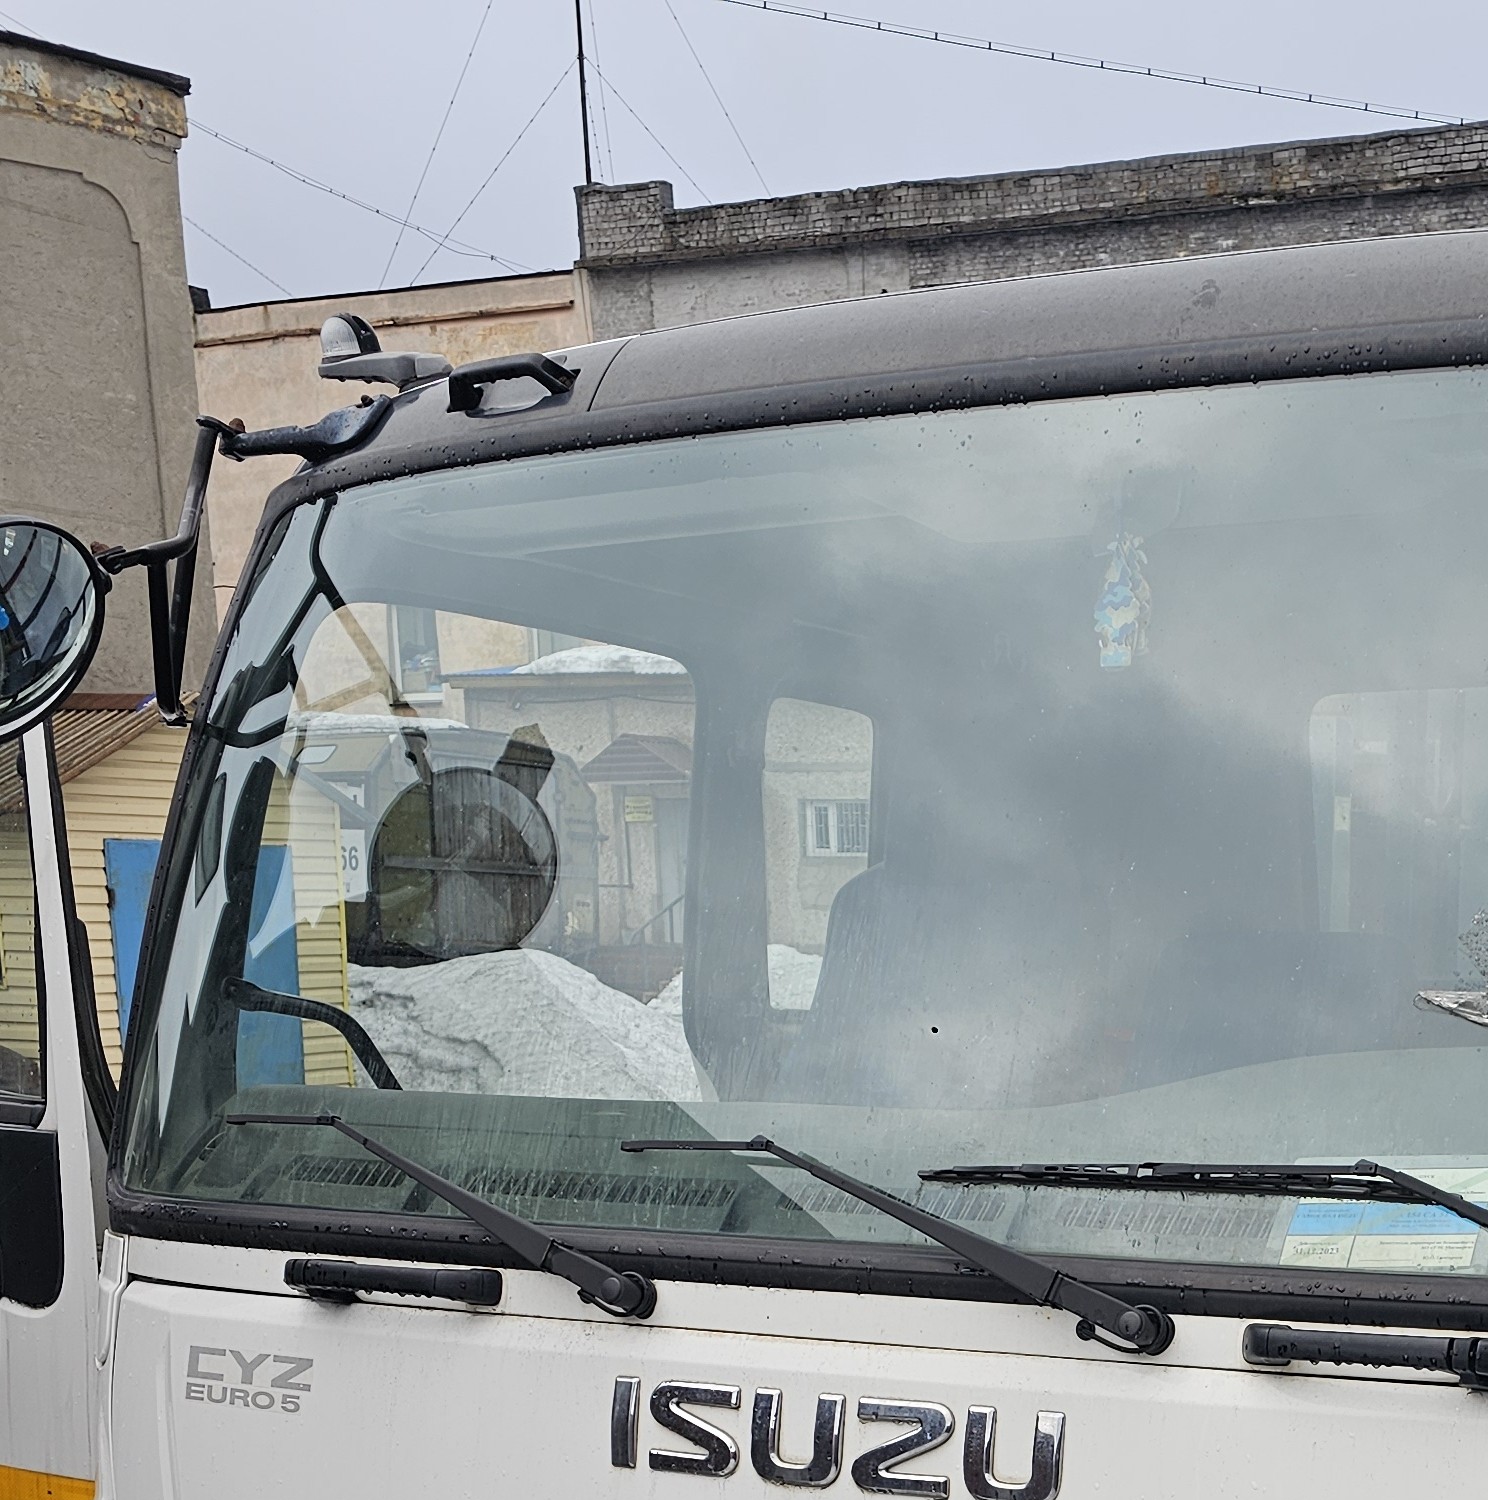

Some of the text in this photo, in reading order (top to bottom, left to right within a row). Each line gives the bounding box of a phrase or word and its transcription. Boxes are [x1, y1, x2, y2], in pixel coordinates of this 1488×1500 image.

[186, 1345, 314, 1392] CYZ
[185, 1382, 301, 1413] EURO 5
